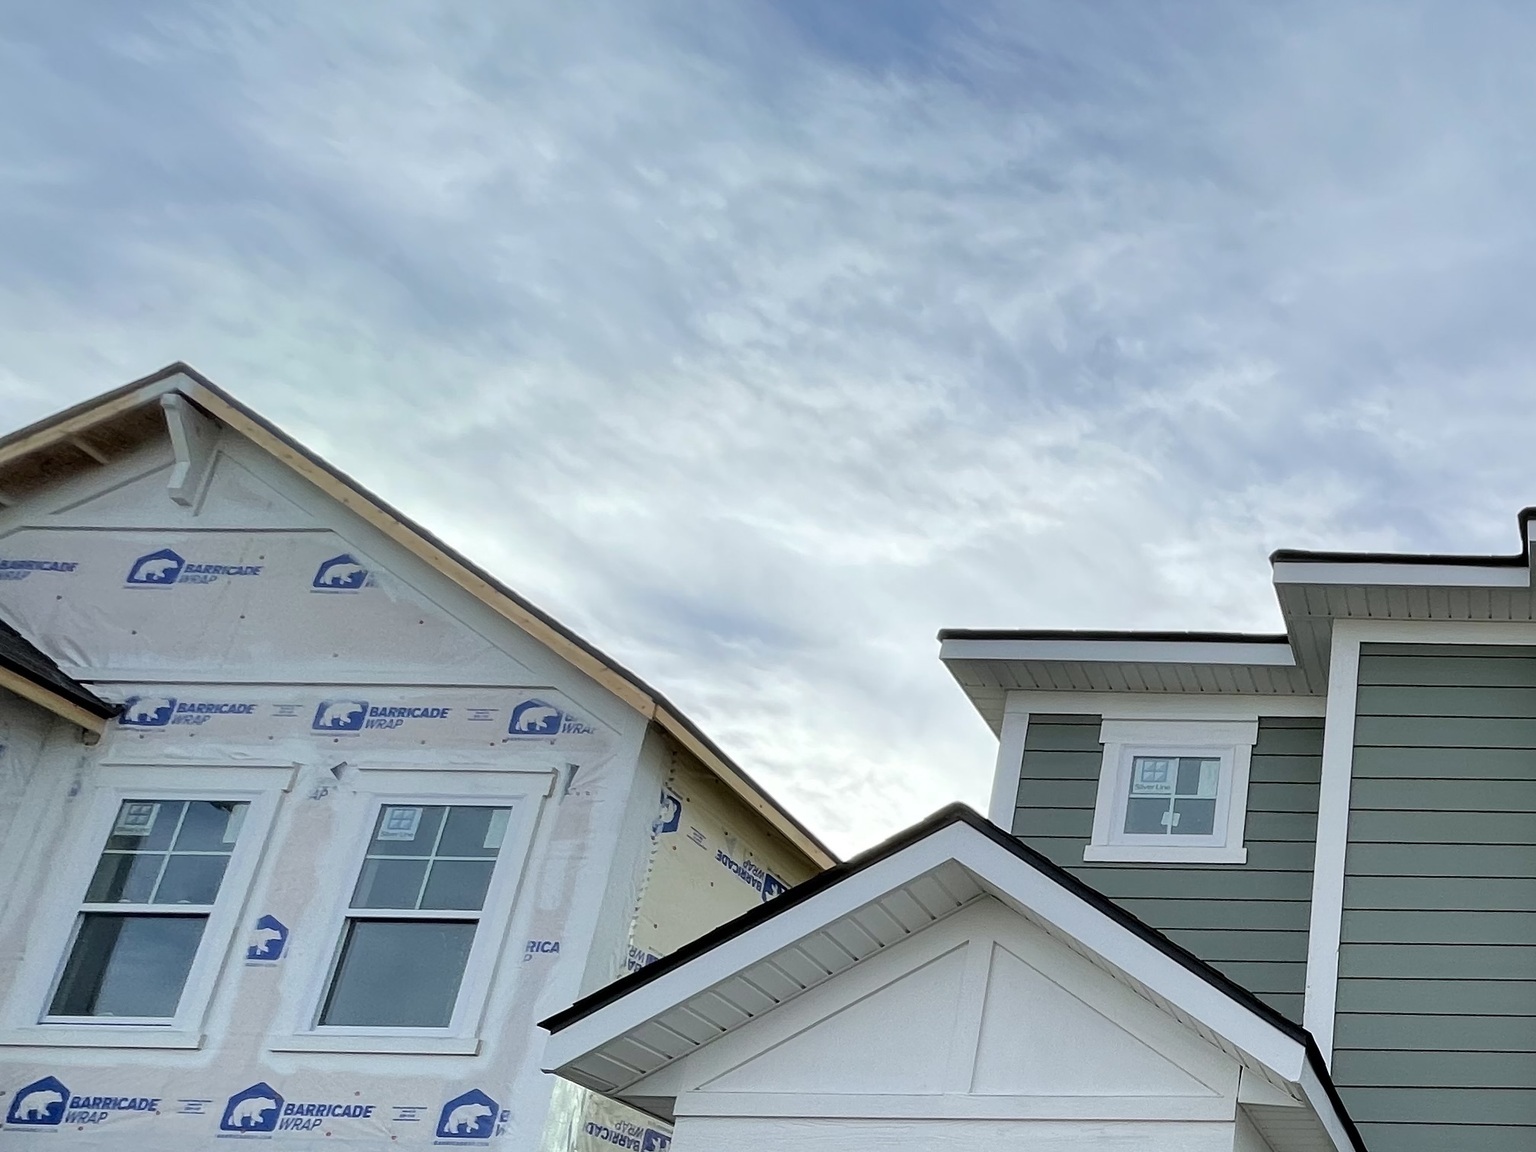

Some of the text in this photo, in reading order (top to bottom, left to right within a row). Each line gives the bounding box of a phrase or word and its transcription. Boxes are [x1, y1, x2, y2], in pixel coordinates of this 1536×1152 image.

[184, 564, 263, 576] BARRICADE
[176, 702, 256, 715] BARRICADE
[369, 706, 452, 719] BARRICADE
[171, 715, 211, 725] WRAP
[365, 718, 404, 730] WRAP
[715, 849, 763, 892] BARRICADE
[70, 1097, 162, 1112] BARRICADE
[283, 1103, 377, 1118] BARRICADE
[65, 1111, 108, 1124] WRAP
[278, 1118, 322, 1131] WRAP
[584, 1121, 641, 1152] BARRICAD
